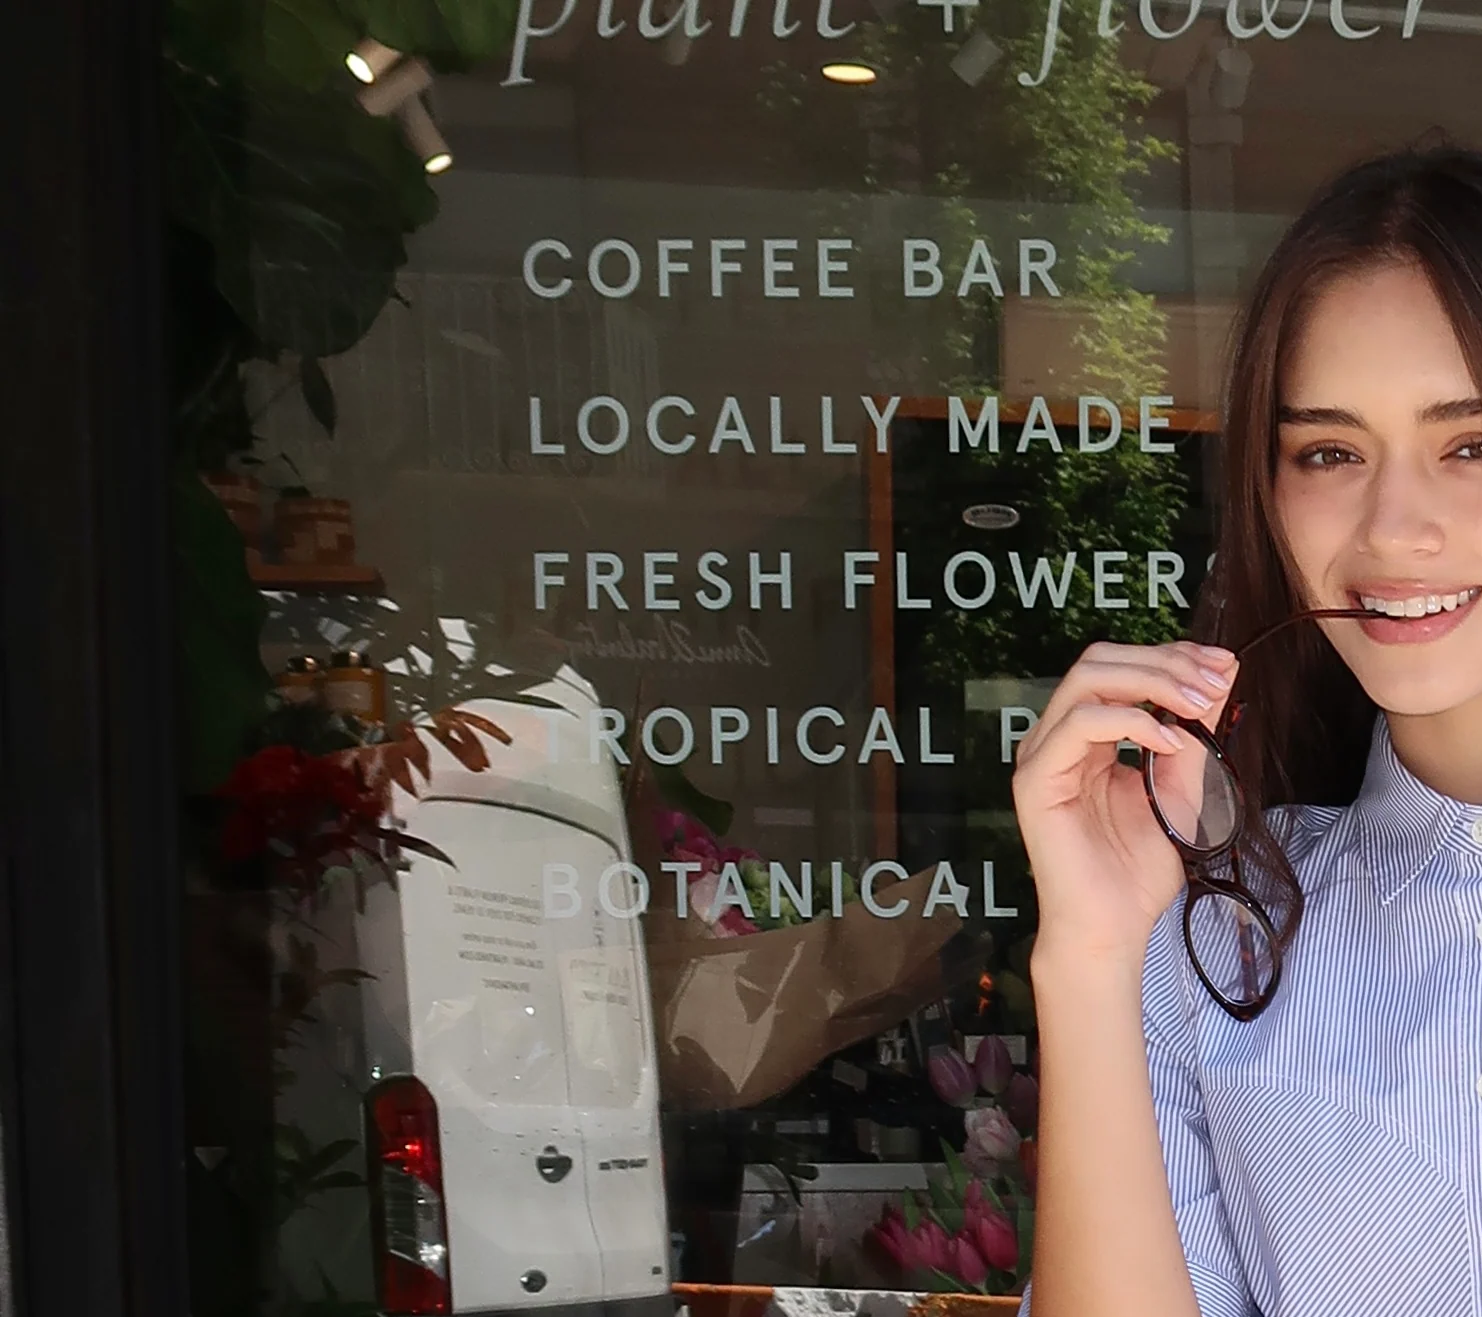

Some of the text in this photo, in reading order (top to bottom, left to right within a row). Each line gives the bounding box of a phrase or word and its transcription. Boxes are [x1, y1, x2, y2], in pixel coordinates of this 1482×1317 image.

[522, 239, 1062, 299] COFFEE BAR
[529, 396, 1177, 456] LOCALLY MADE
[533, 551, 1227, 611] FRESH FLOWER
[531, 706, 955, 766] TROPICAL
[541, 860, 1020, 920] BOTANICAL
